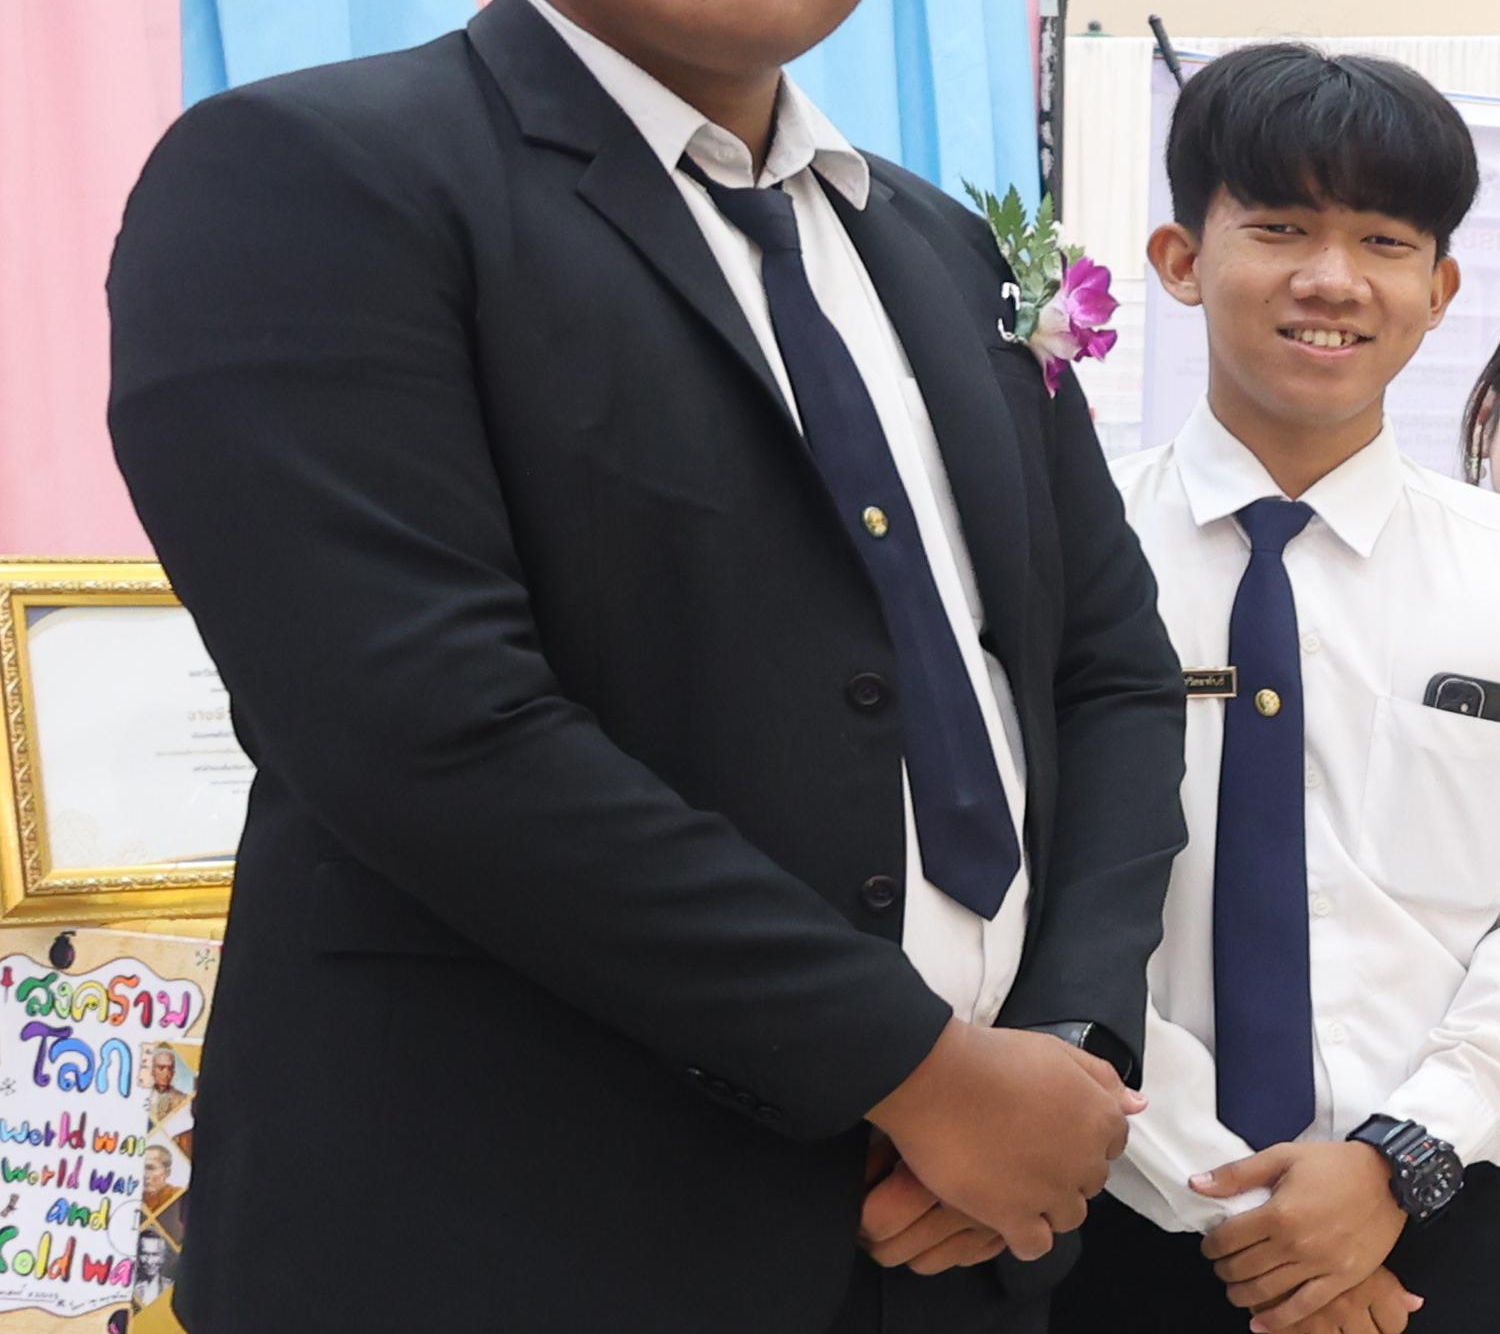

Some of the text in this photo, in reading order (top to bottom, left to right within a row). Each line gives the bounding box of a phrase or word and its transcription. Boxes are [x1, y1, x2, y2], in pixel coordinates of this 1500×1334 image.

[16, 972, 191, 1028] สงคราม
[20, 1020, 133, 1098] โลก
